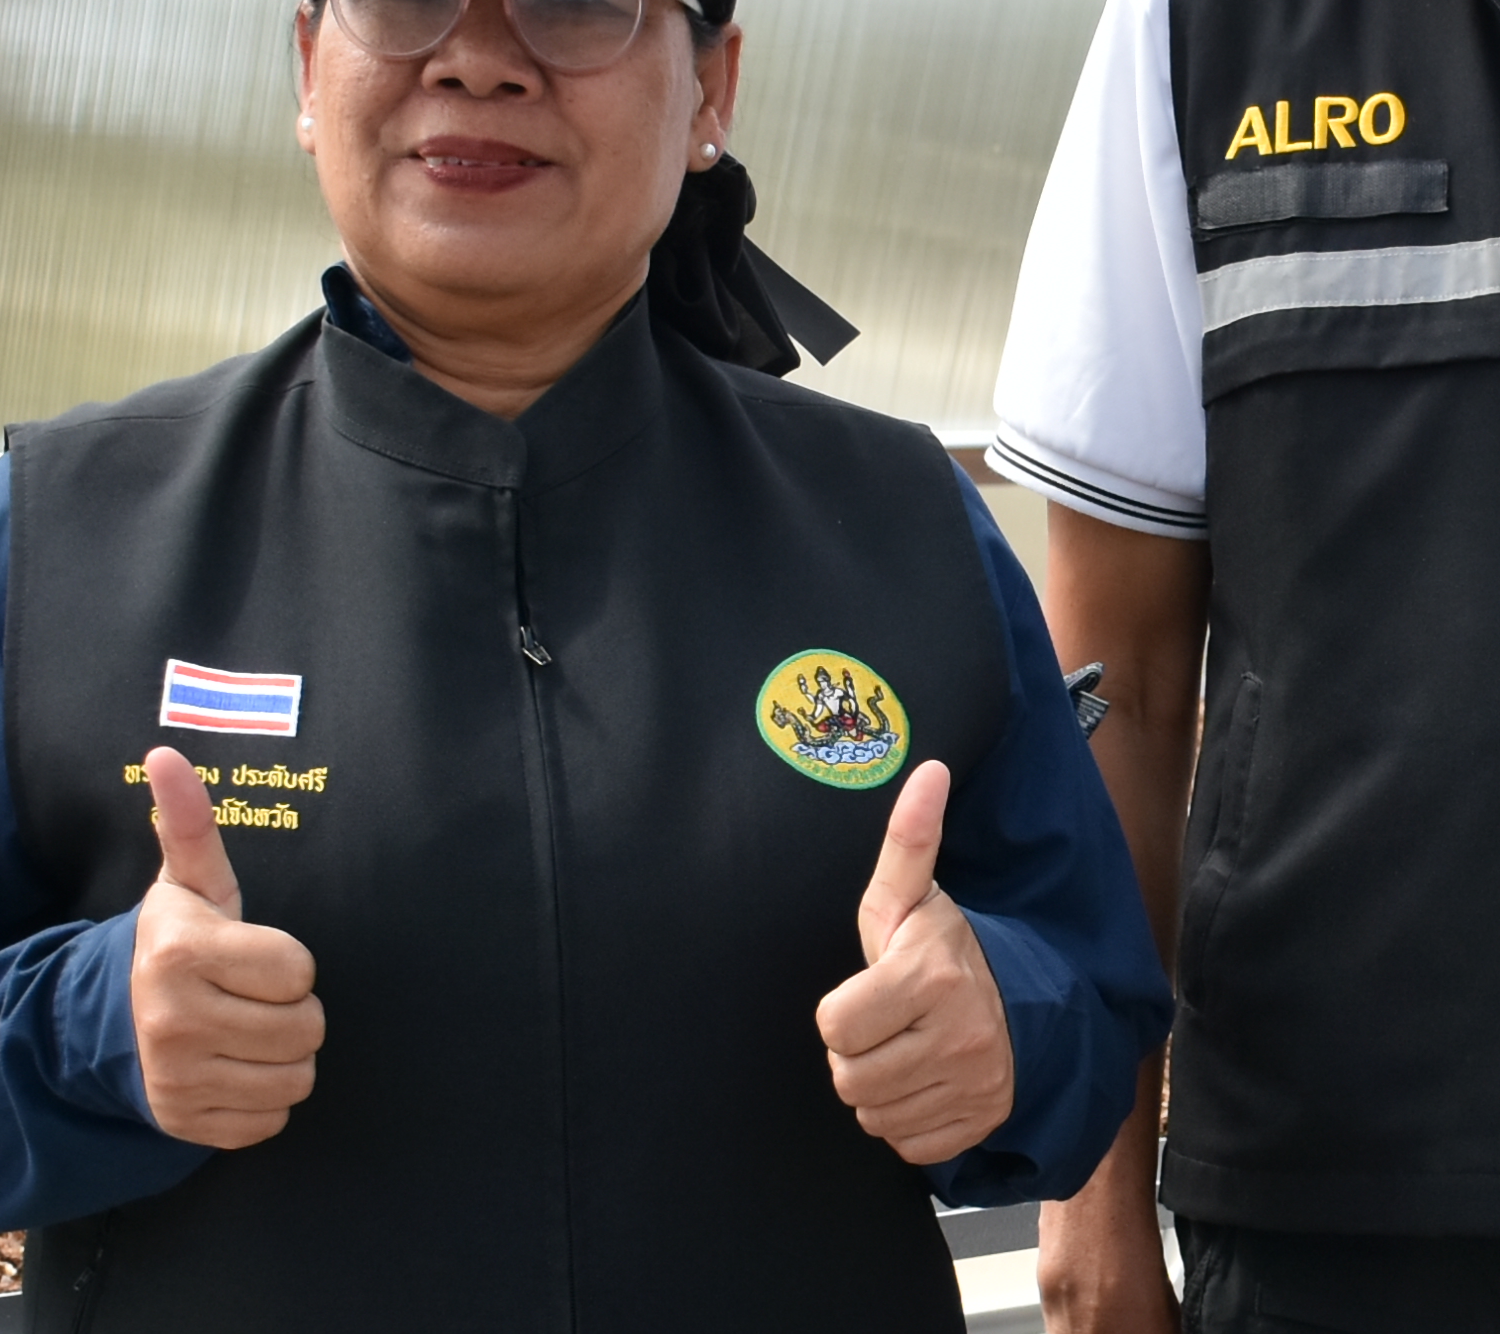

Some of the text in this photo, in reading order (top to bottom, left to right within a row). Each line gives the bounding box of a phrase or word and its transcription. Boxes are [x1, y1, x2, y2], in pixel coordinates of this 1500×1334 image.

[1224, 91, 1406, 160] ALRO
[232, 763, 329, 793] ประดับศรี
